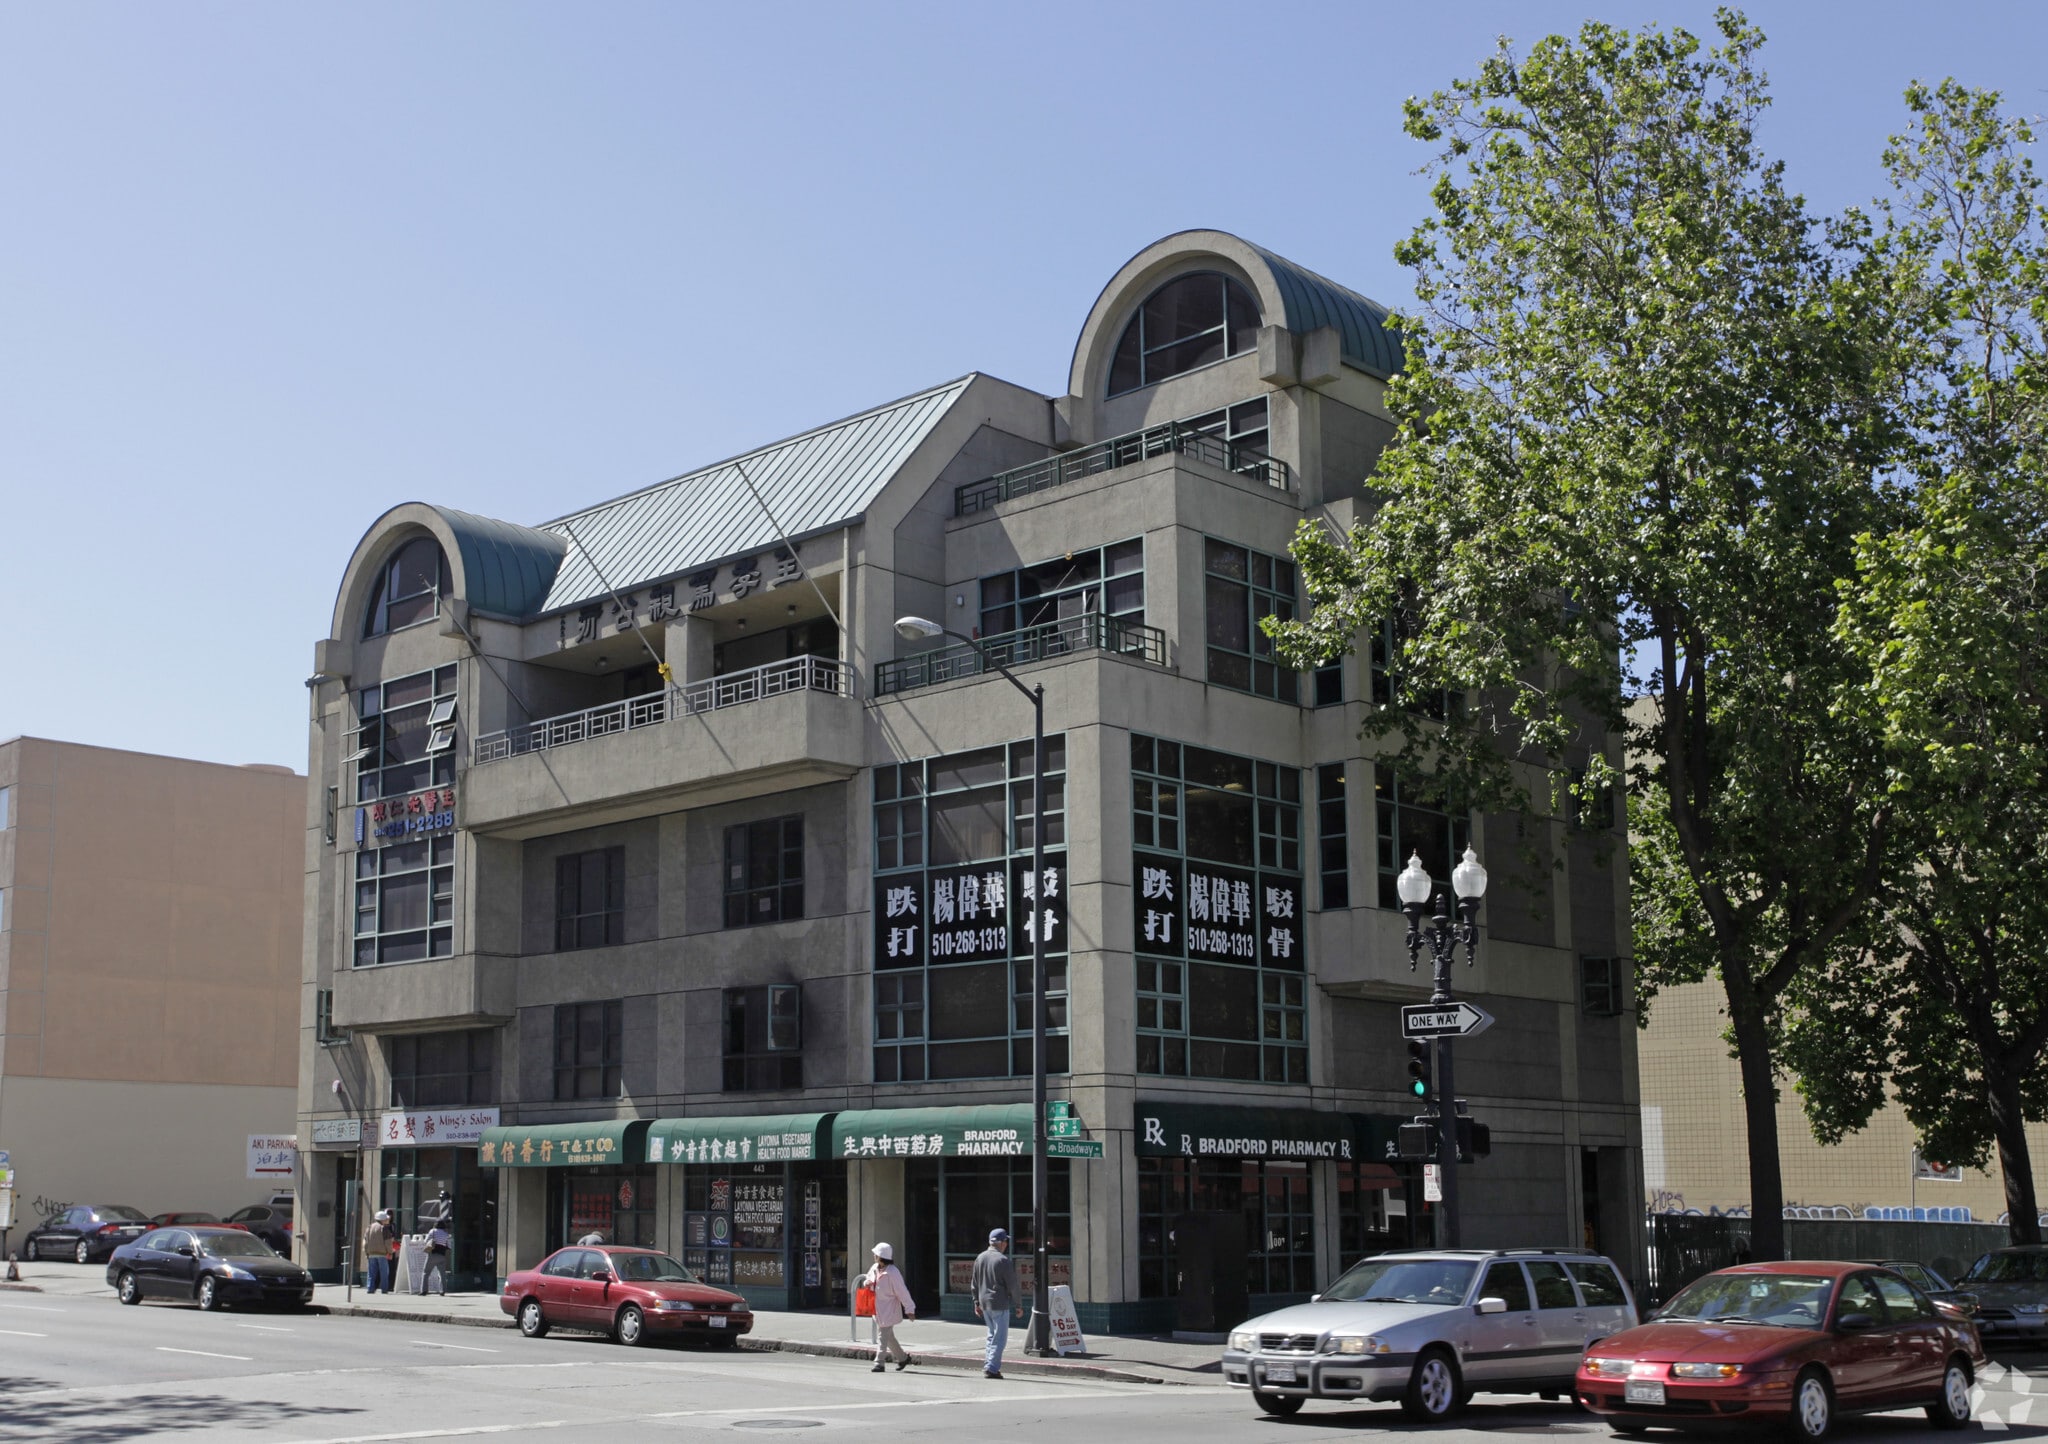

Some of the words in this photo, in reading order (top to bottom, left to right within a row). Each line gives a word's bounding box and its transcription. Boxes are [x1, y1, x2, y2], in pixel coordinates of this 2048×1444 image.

[932, 870, 1006, 925] 楊偉華
[1142, 866, 1175, 943] 跌打
[1189, 872, 1251, 926] 楊偉華
[886, 885, 919, 958] 跌打
[932, 926, 1006, 956] 510-268-1313
[1189, 926, 1254, 958] 510-268-1313
[1411, 1015, 1433, 1027] ONE
[1436, 1013, 1458, 1025] WAY
[440, 1114, 466, 1129] Ming's
[470, 1112, 492, 1125] Salon
[758, 1134, 780, 1147] LAYONNA
[782, 1132, 812, 1146] VEGETARIAN
[964, 1129, 1017, 1141] BRADFORD
[252, 1139, 265, 1149] AKI
[267, 1139, 297, 1150] PARKING
[561, 1140, 570, 1153] T
[572, 1139, 582, 1153] &
[585, 1139, 595, 1152] T
[596, 1137, 616, 1152] CO.
[671, 1137, 752, 1161] 妙音素食超市
[957, 1141, 1024, 1156] PHARMACY
[1058, 1142, 1094, 1157] Broadway
[1199, 1137, 1267, 1155] BRADFORD
[1271, 1139, 1337, 1158] PHARMACY
[757, 1147, 776, 1160] HEALTH
[777, 1147, 791, 1159] FOOD
[791, 1146, 811, 1158] MARKET
[753, 1164, 765, 1173] 443
[734, 1200, 755, 1212] LAYONNA
[755, 1200, 784, 1212] VEGETARIAN
[734, 1212, 752, 1223] HEALTH
[752, 1212, 764, 1223] FOOD
[764, 1212, 783, 1224] MARKET
